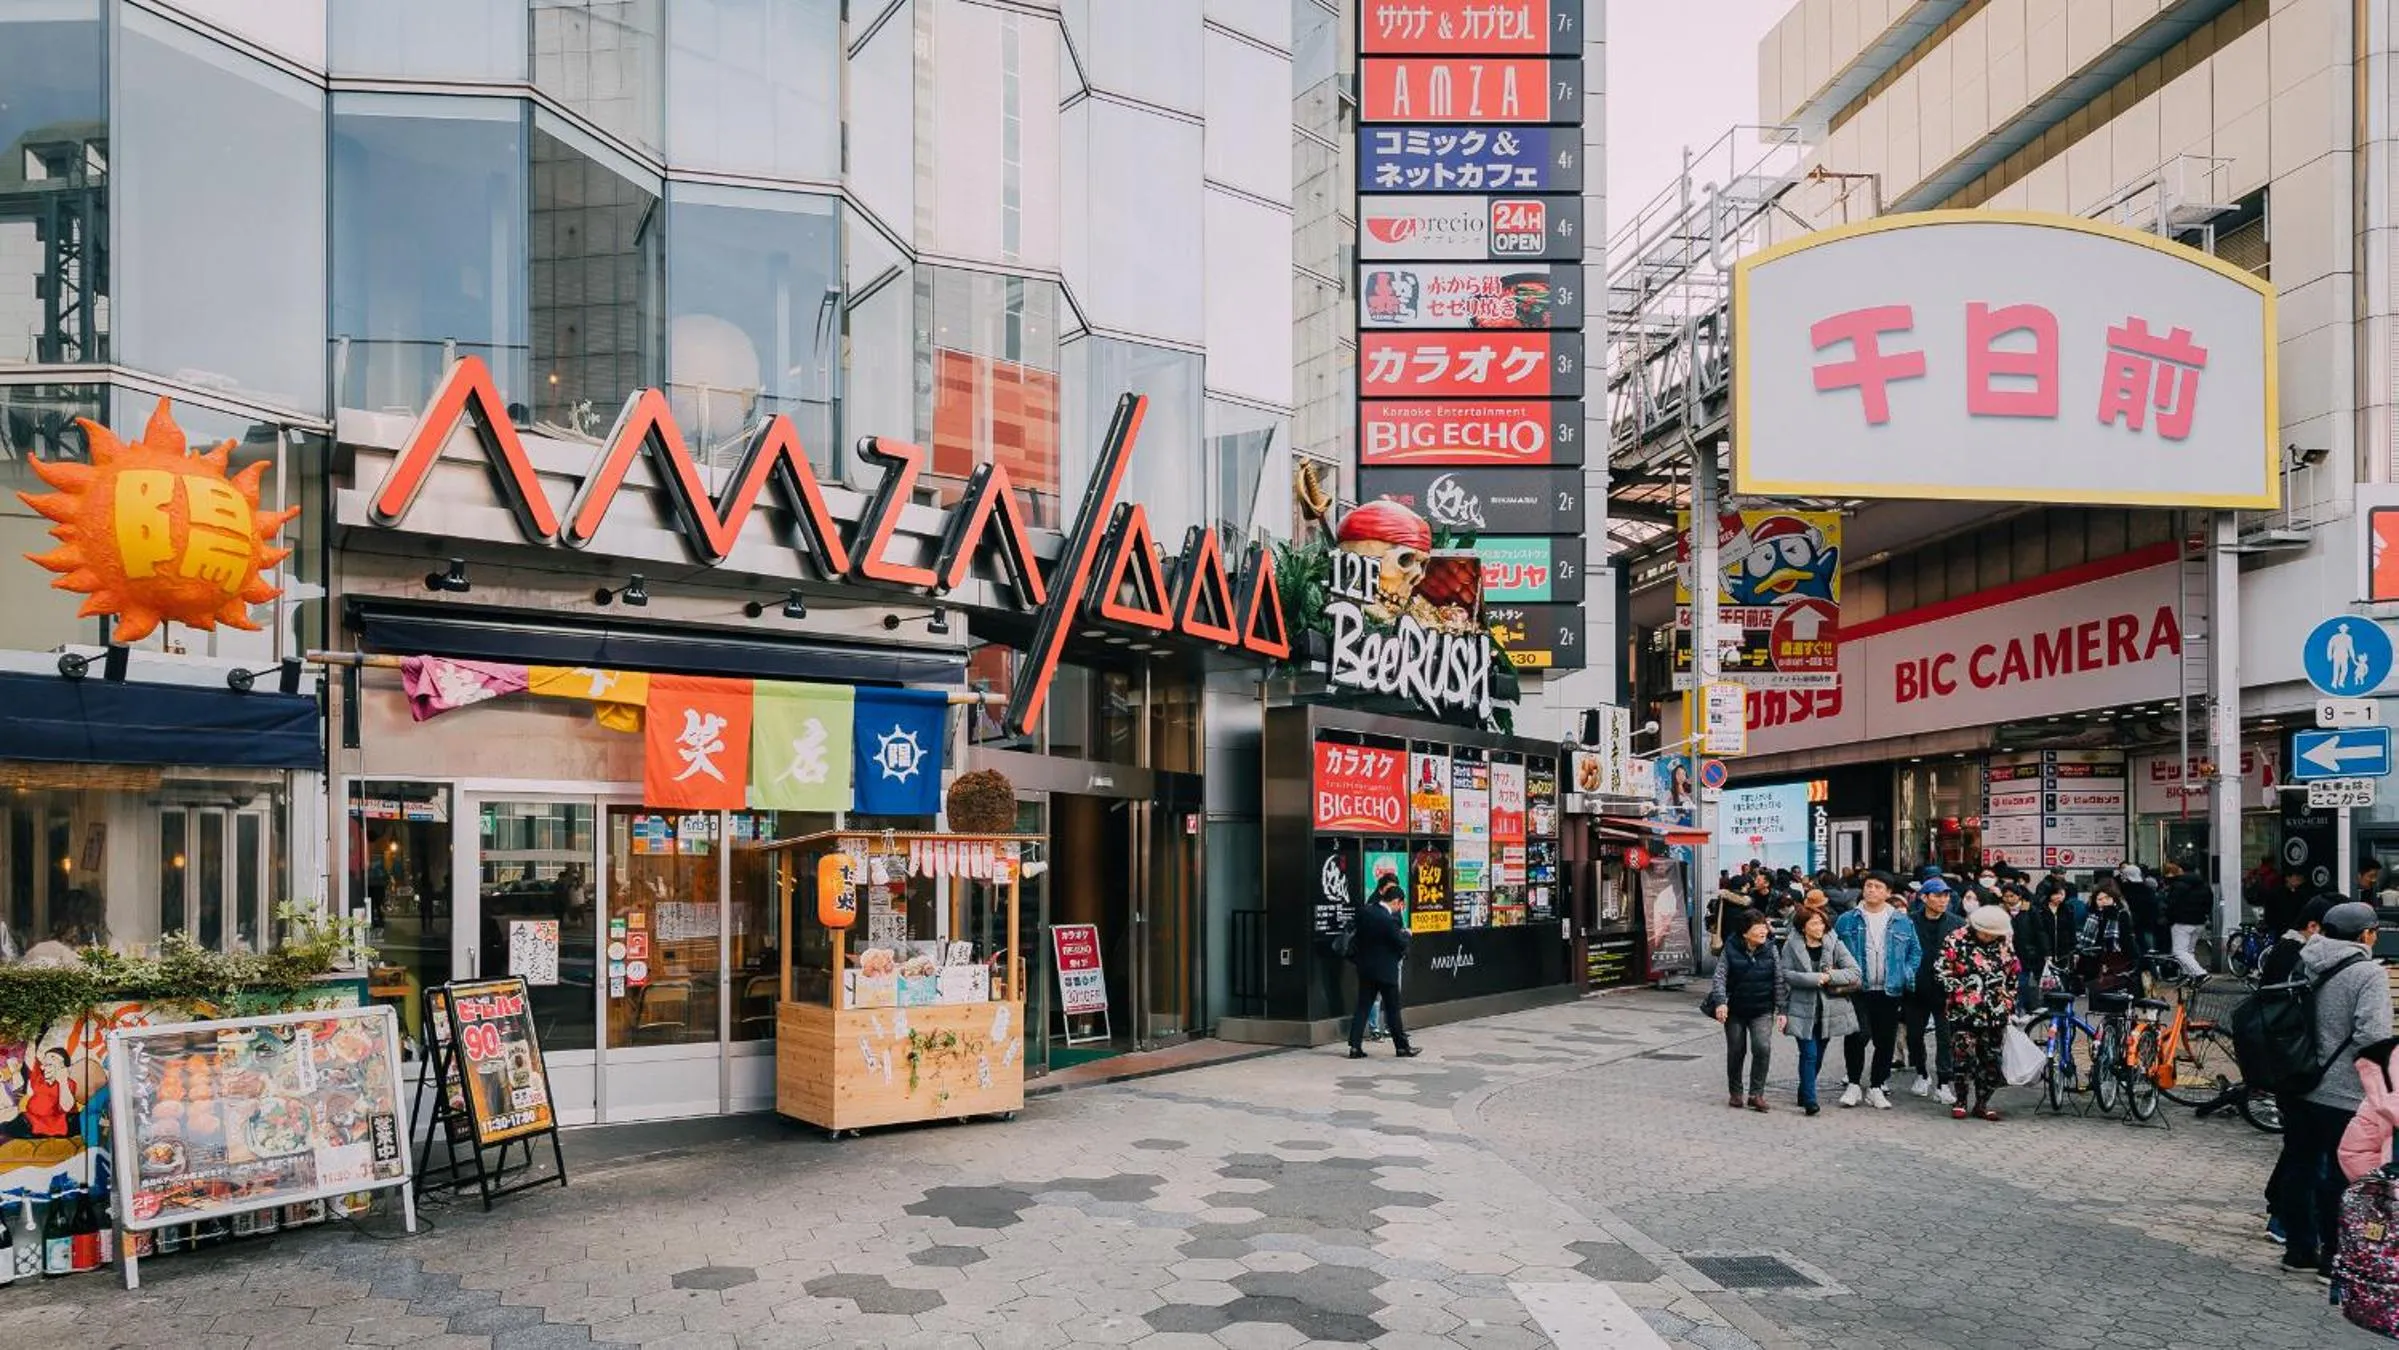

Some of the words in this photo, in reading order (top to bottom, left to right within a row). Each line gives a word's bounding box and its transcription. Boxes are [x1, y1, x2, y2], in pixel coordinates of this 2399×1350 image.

[1377, 6, 1433, 39] サウナ
[1438, 11, 1454, 39] &
[1461, 5, 1535, 39] カプセル
[1557, 13, 1574, 33] 7F
[1393, 64, 1519, 116] AMZA
[1557, 82, 1574, 101] 7F
[1376, 130, 1487, 156] コミック
[1492, 130, 1520, 157] &
[1557, 150, 1574, 169] 4F
[1376, 163, 1538, 189] ネットカフェ
[1494, 204, 1542, 230] 24H
[1494, 232, 1542, 251] OPEN
[1557, 223, 1574, 237] 4F
[1426, 275, 1502, 297] 赤から鍋
[1557, 287, 1574, 305] 3F
[1366, 346, 1545, 384] カラオケ
[1557, 355, 1574, 374] 3F
[1810, 302, 2208, 442] 千日前
[1382, 406, 1431, 417] Karaoke
[1437, 406, 1527, 417] Entertainment
[1366, 420, 1436, 456] BIG
[1443, 420, 1545, 454] ECHO
[1557, 423, 1575, 442] 3F
[1557, 491, 1575, 512] 2F
[1328, 548, 1381, 602] 12F
[1559, 560, 1575, 579] 2F
[1559, 627, 1575, 646] 2F
[1895, 652, 1957, 705] BIC
[1968, 605, 2181, 690] CAMERA
[672, 707, 728, 784] 笑
[1325, 746, 1395, 778] カラオケ
[1319, 791, 1353, 822] BIG
[1353, 795, 1401, 825] ECHO
[2311, 793, 2372, 806] ここから
[462, 1022, 499, 1062] 90
